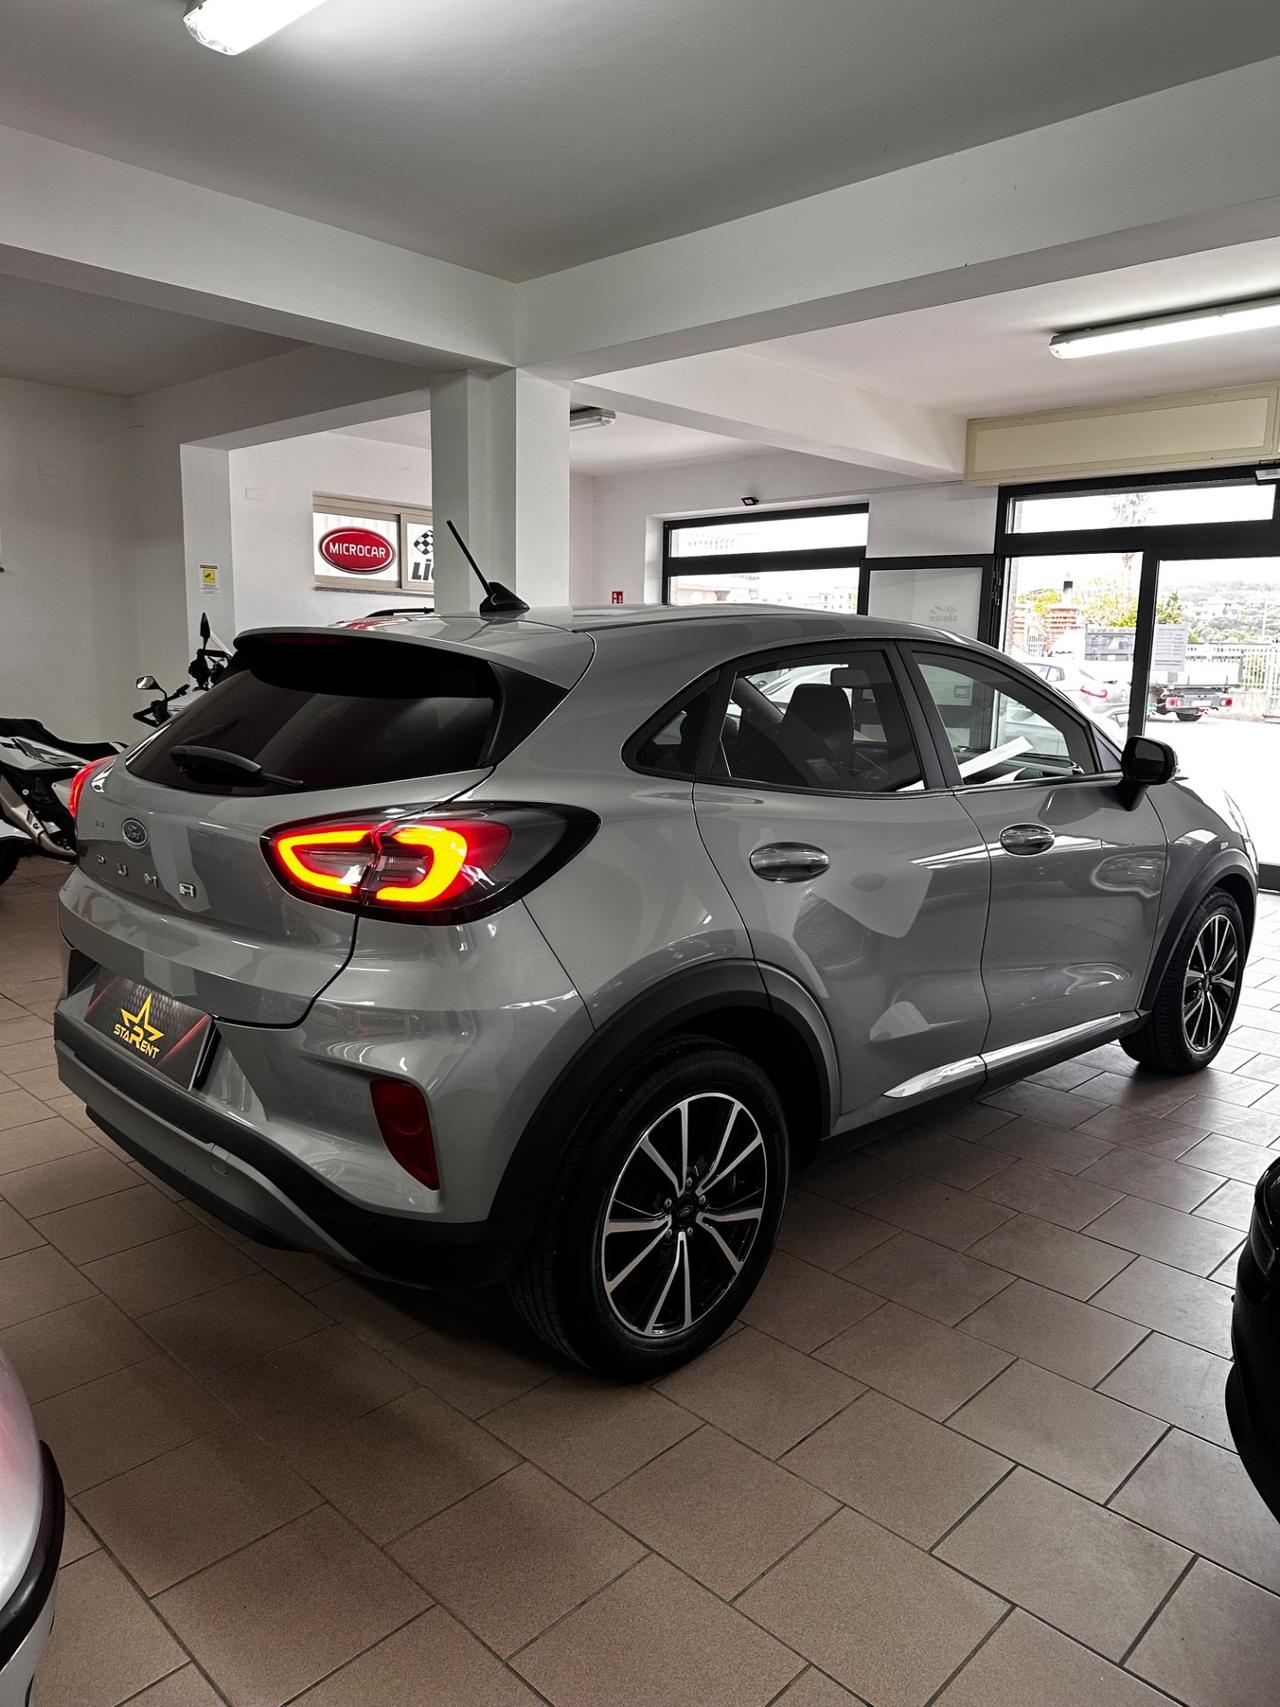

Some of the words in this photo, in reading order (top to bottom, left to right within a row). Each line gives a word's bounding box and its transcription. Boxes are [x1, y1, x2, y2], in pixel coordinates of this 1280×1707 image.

[329, 542, 386, 558] MICROCAR
[411, 558, 434, 581] Li
[97, 854, 195, 897] PUMA
